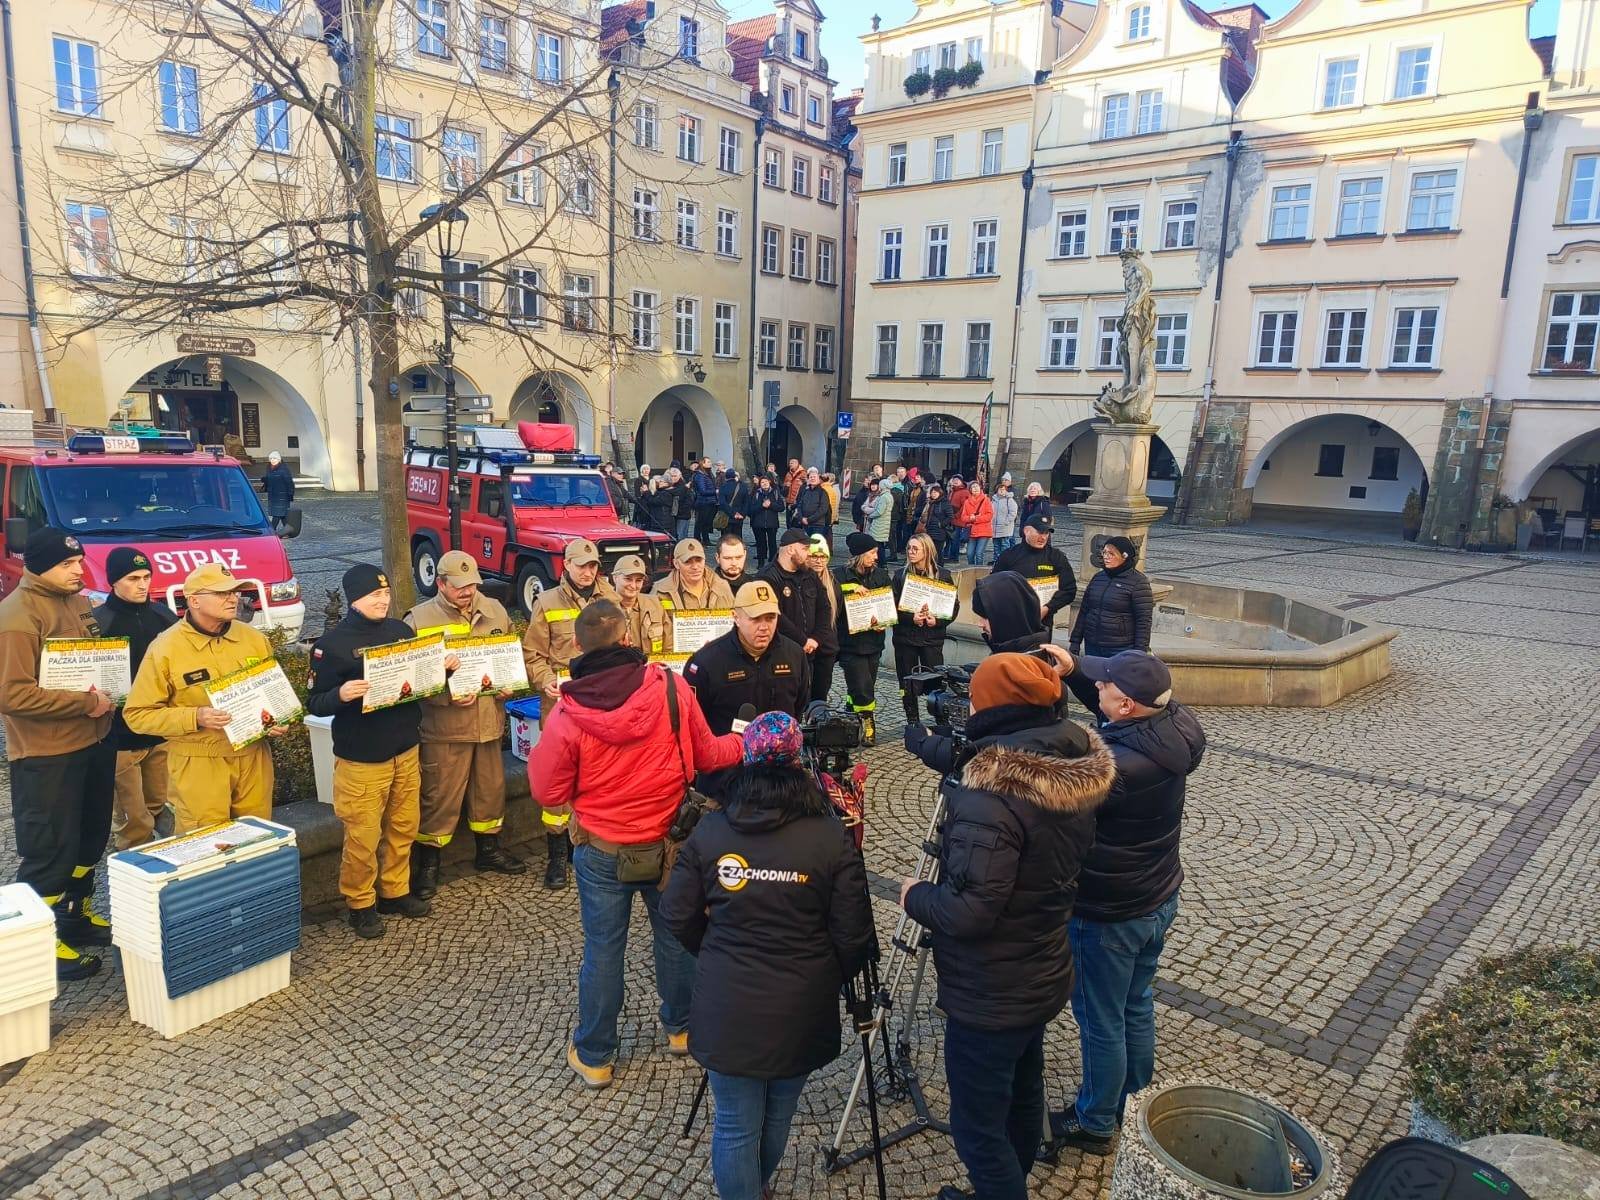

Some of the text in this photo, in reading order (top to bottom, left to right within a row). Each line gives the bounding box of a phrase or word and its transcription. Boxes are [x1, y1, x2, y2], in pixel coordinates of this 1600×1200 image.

[48, 657, 77, 665] PACZKA
[93, 655, 115, 663] SENIORA
[369, 661, 393, 670] PACZKA
[407, 651, 430, 661] SENIORA
